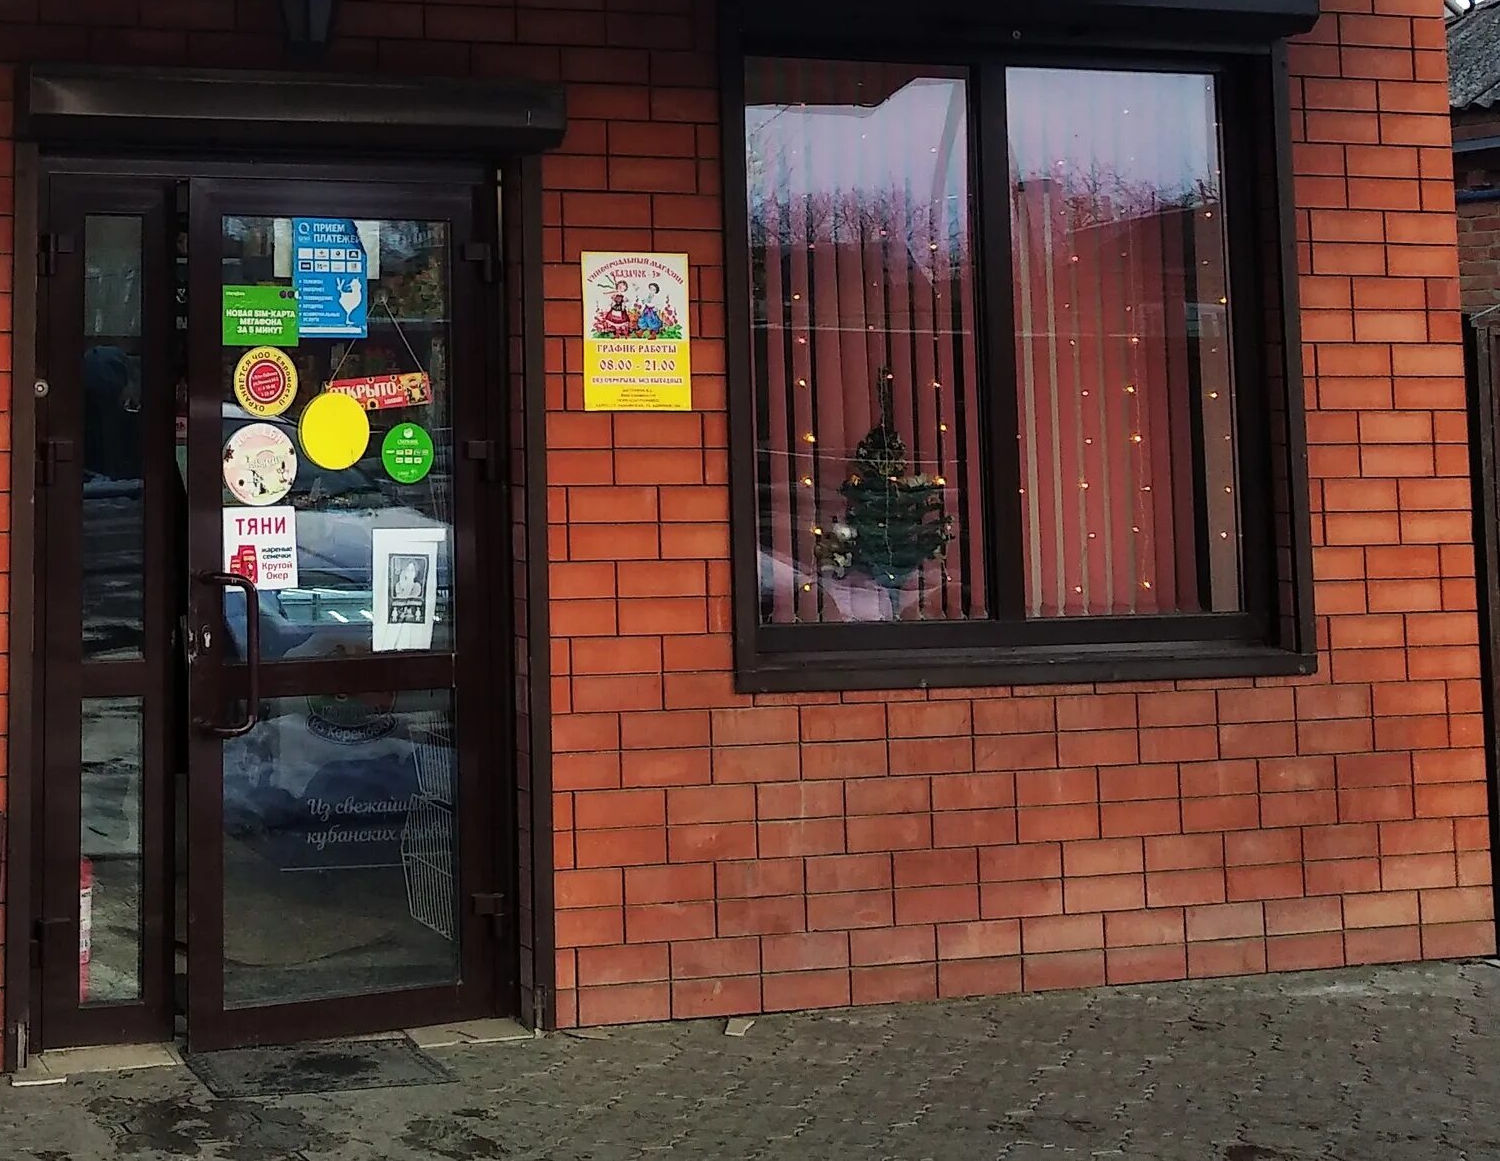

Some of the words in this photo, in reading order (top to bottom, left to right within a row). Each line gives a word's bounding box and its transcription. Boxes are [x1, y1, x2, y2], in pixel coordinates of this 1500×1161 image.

[313, 223, 346, 233] ПРИЕМ
[254, 310, 295, 318] SIM-КАРТА
[237, 326, 248, 334] ЗА
[255, 326, 283, 334] МИНУТ
[597, 344, 636, 353] ГРАФИК
[638, 344, 676, 353] РАБОТЫ
[600, 359, 632, 370] 08.00
[644, 359, 676, 371] 21.00
[239, 359, 265, 412] ОХРАНЯЕТСЯ
[235, 516, 286, 536] ТЯНИ
[261, 545, 292, 554] жареные
[262, 561, 293, 571] Крутой
[266, 571, 289, 580] Окер
[307, 798, 330, 822] Из
[307, 824, 397, 850] кубанских
